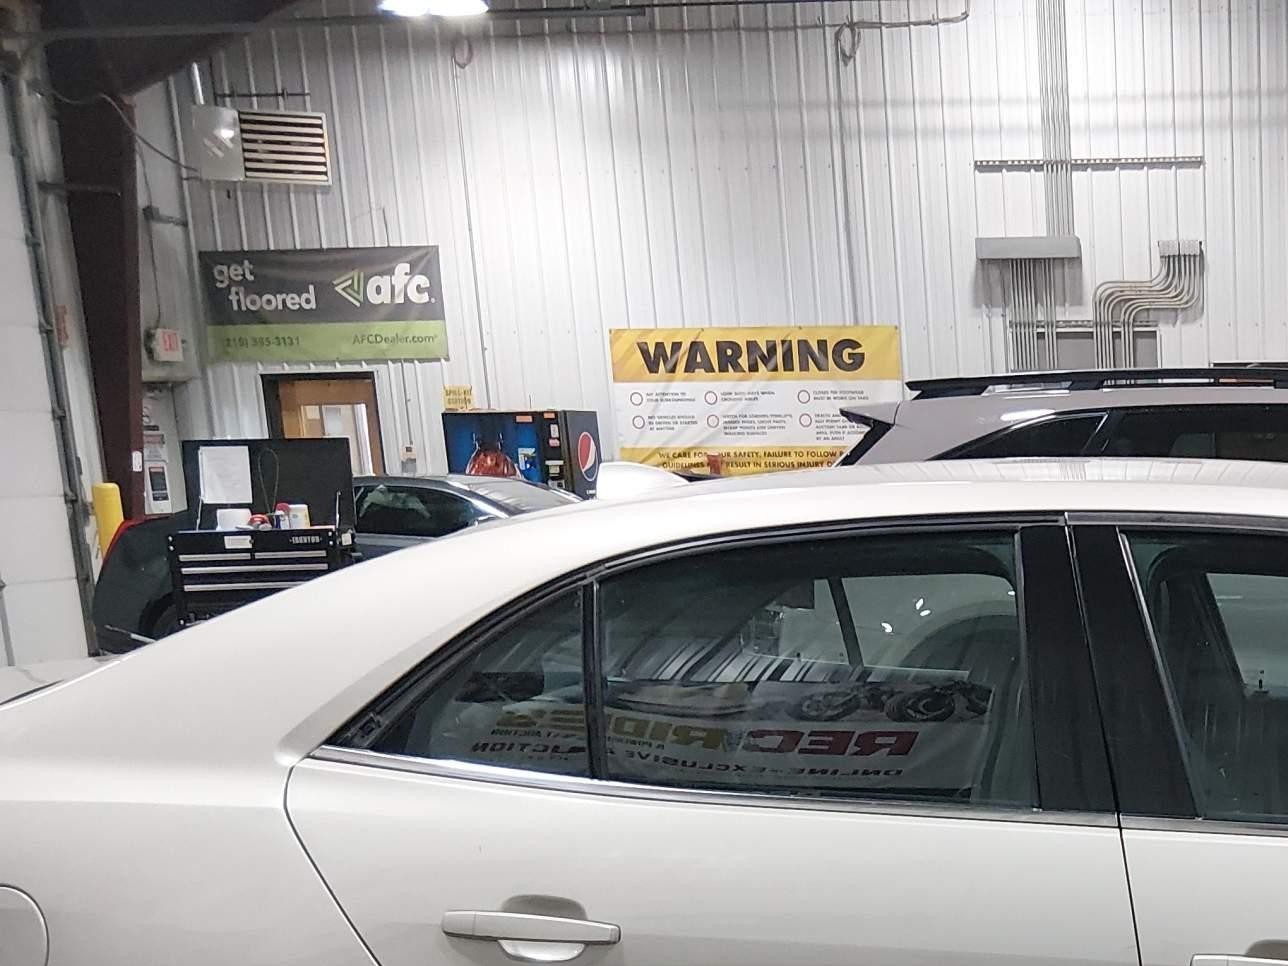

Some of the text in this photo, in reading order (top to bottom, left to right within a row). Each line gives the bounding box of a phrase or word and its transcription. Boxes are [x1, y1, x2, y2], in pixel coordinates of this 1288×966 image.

[213, 260, 255, 288] get
[228, 284, 317, 311] floored
[636, 339, 866, 374] WARNING
[672, 451, 691, 459] CARE
[764, 450, 792, 458] FAILURE
[793, 450, 804, 458] TO
[806, 450, 837, 458] FOLLOW
[797, 460, 824, 468] INJURY
